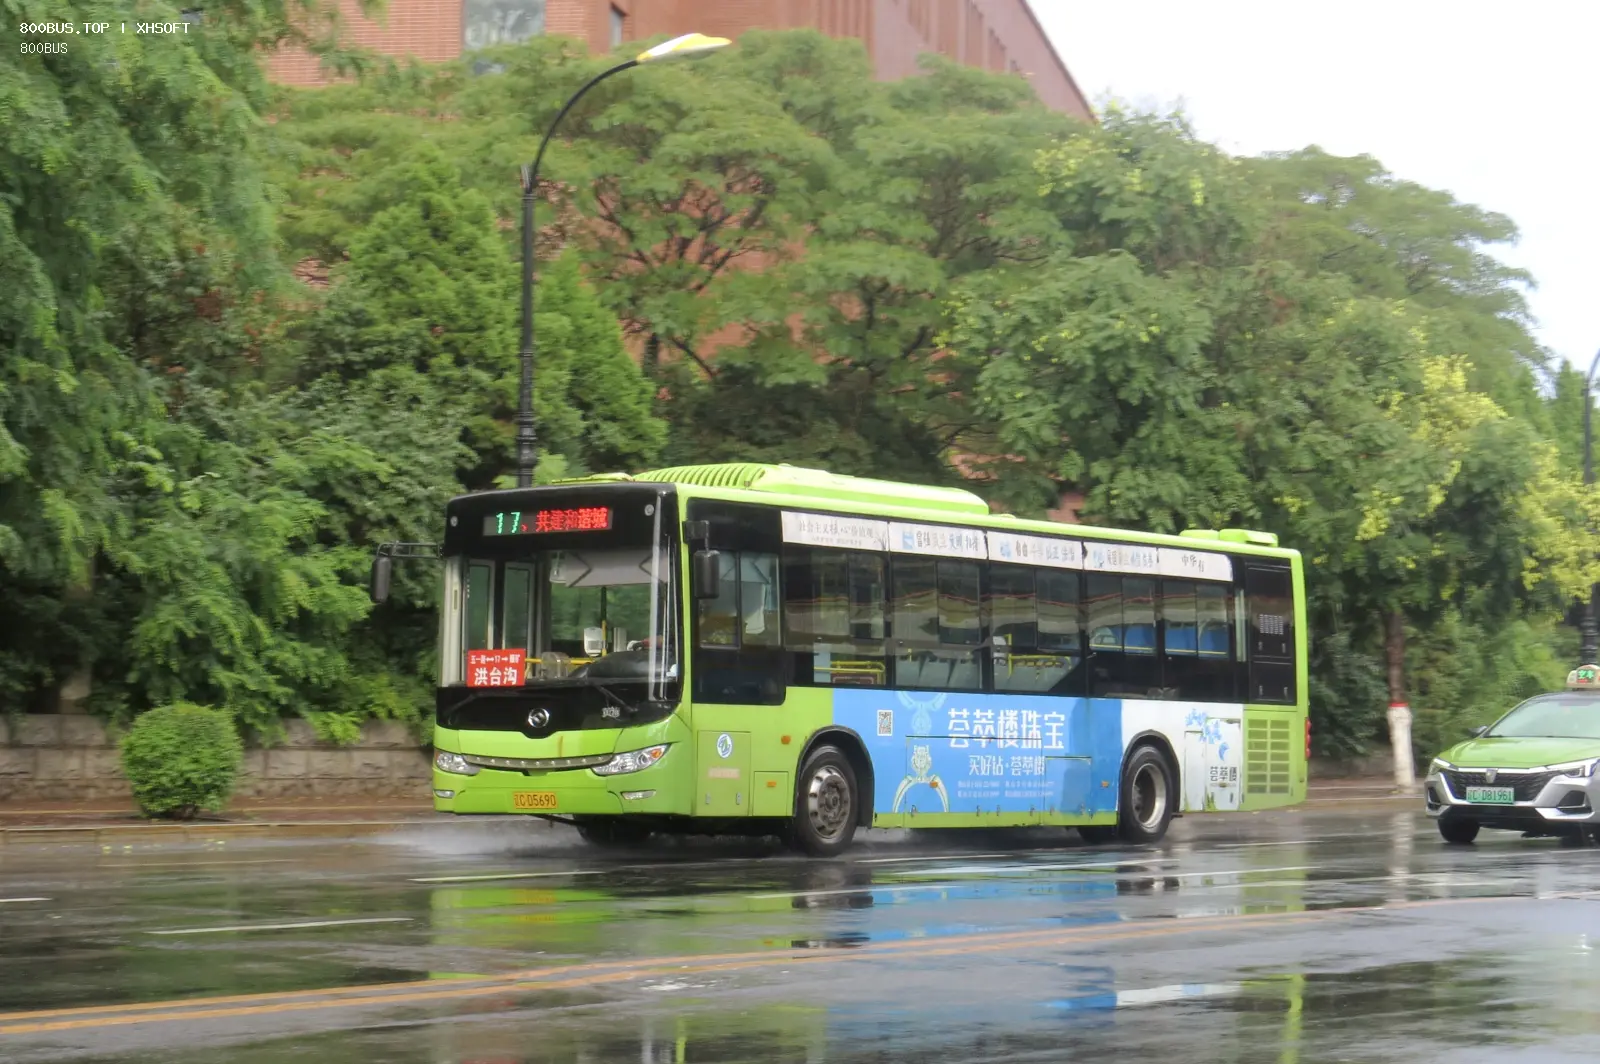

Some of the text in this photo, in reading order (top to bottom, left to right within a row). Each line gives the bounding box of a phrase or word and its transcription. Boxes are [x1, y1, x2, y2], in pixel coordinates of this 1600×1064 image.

[474, 666, 518, 687] 洪台沟
[947, 707, 1065, 750] 荟萃楼珠宝
